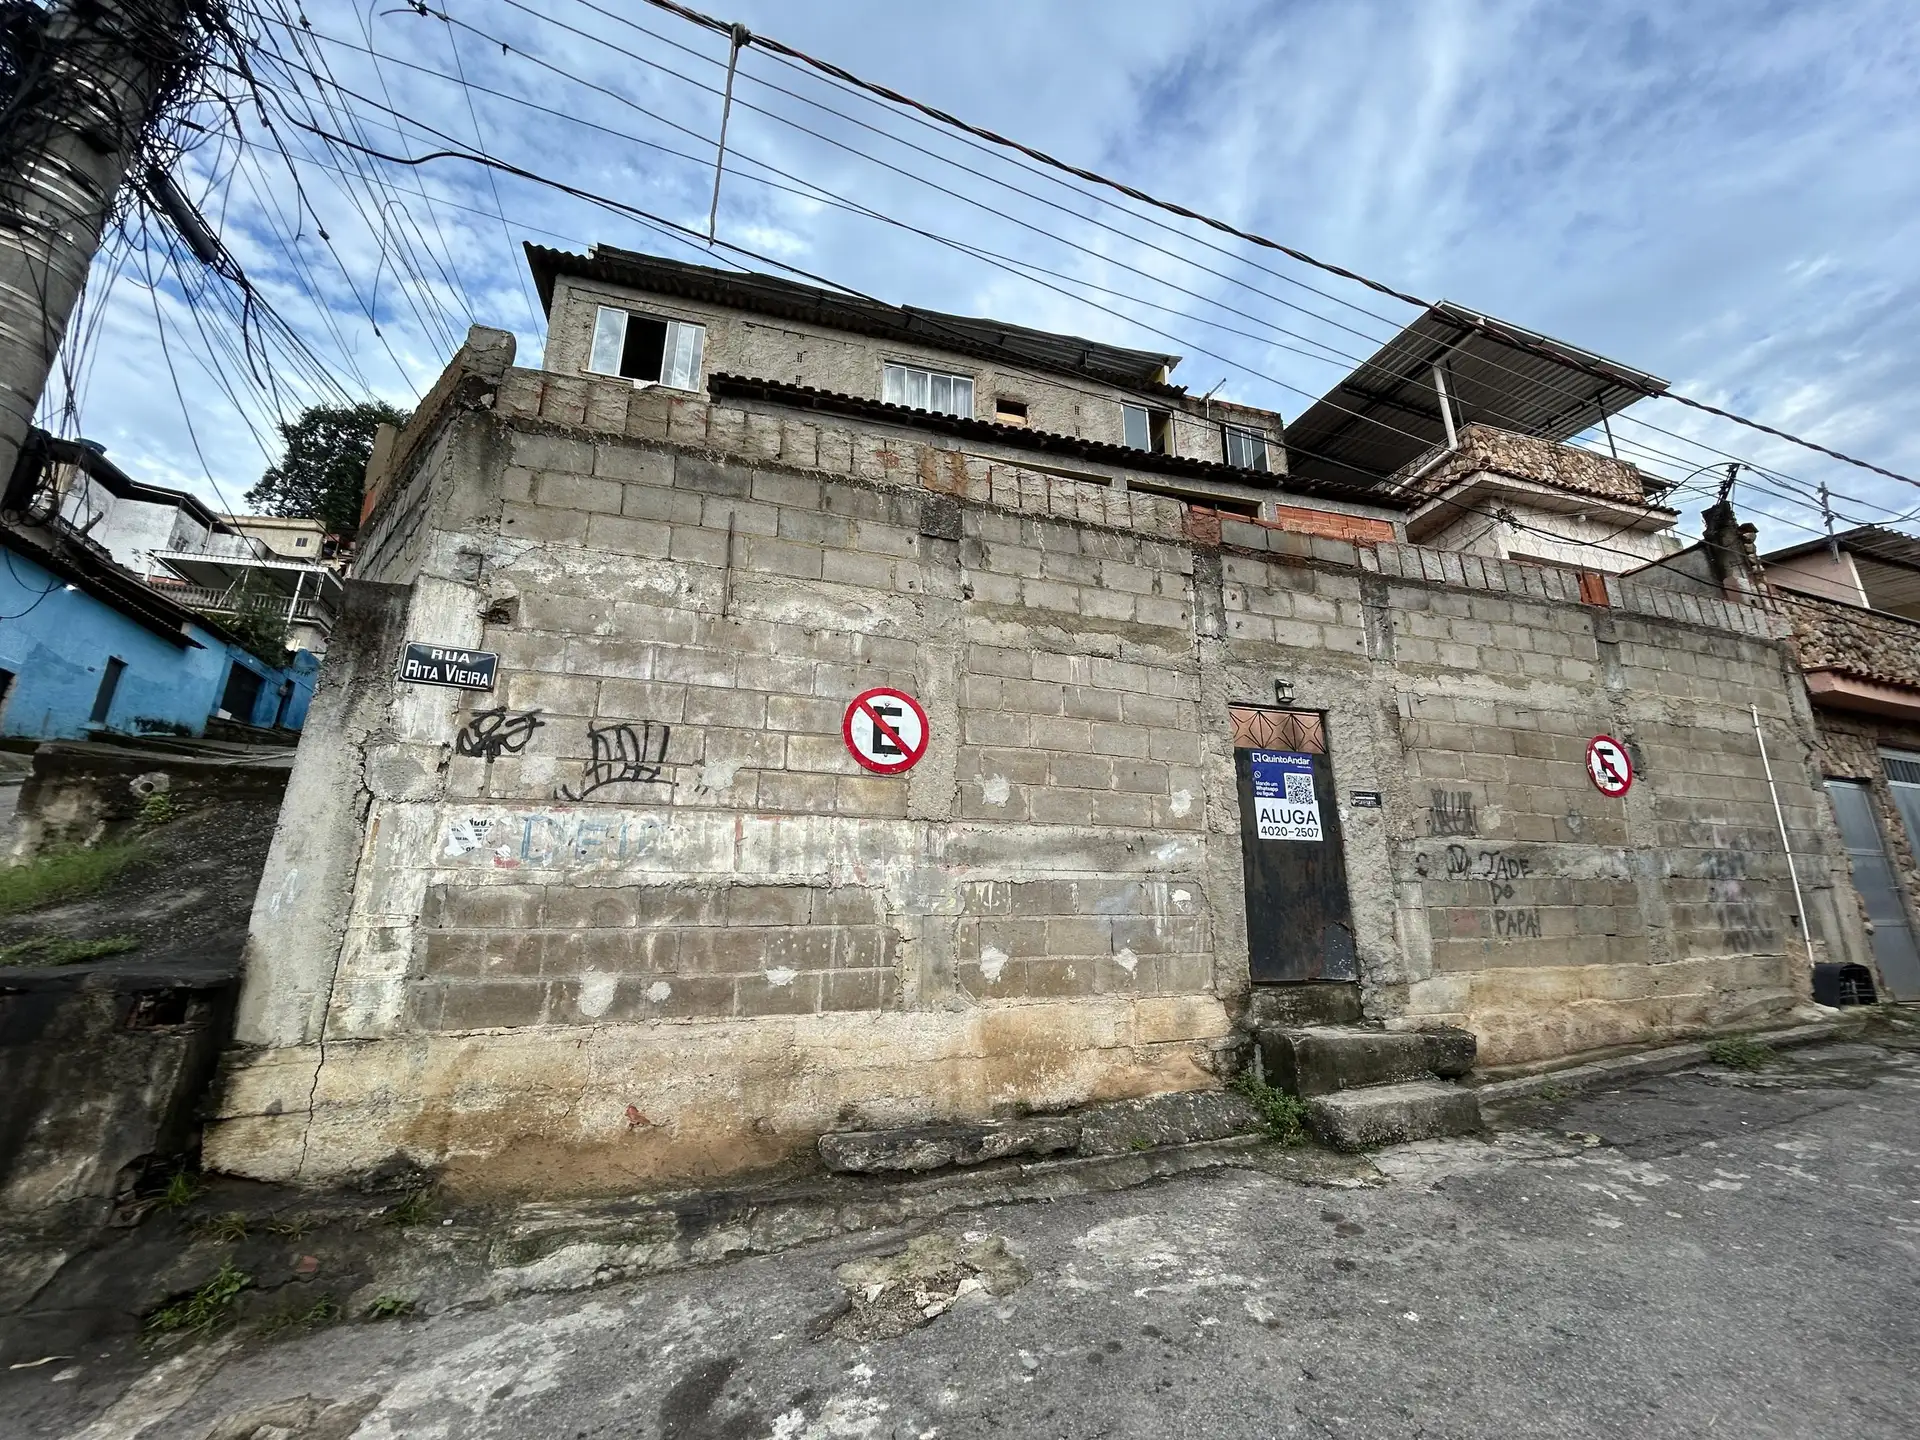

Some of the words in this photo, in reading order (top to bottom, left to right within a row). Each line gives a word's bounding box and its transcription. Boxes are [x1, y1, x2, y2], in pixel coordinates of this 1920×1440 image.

[431, 648, 470, 664] RUA
[405, 659, 438, 680] RITA
[445, 663, 489, 686] VIEIRA
[872, 705, 902, 755] E
[1261, 753, 1311, 765] QuintoAndar
[1597, 748, 1619, 783] E
[1260, 808, 1318, 825] ALUGA
[1260, 825, 1319, 838] 4020-2507
[1491, 881, 1515, 904] DO
